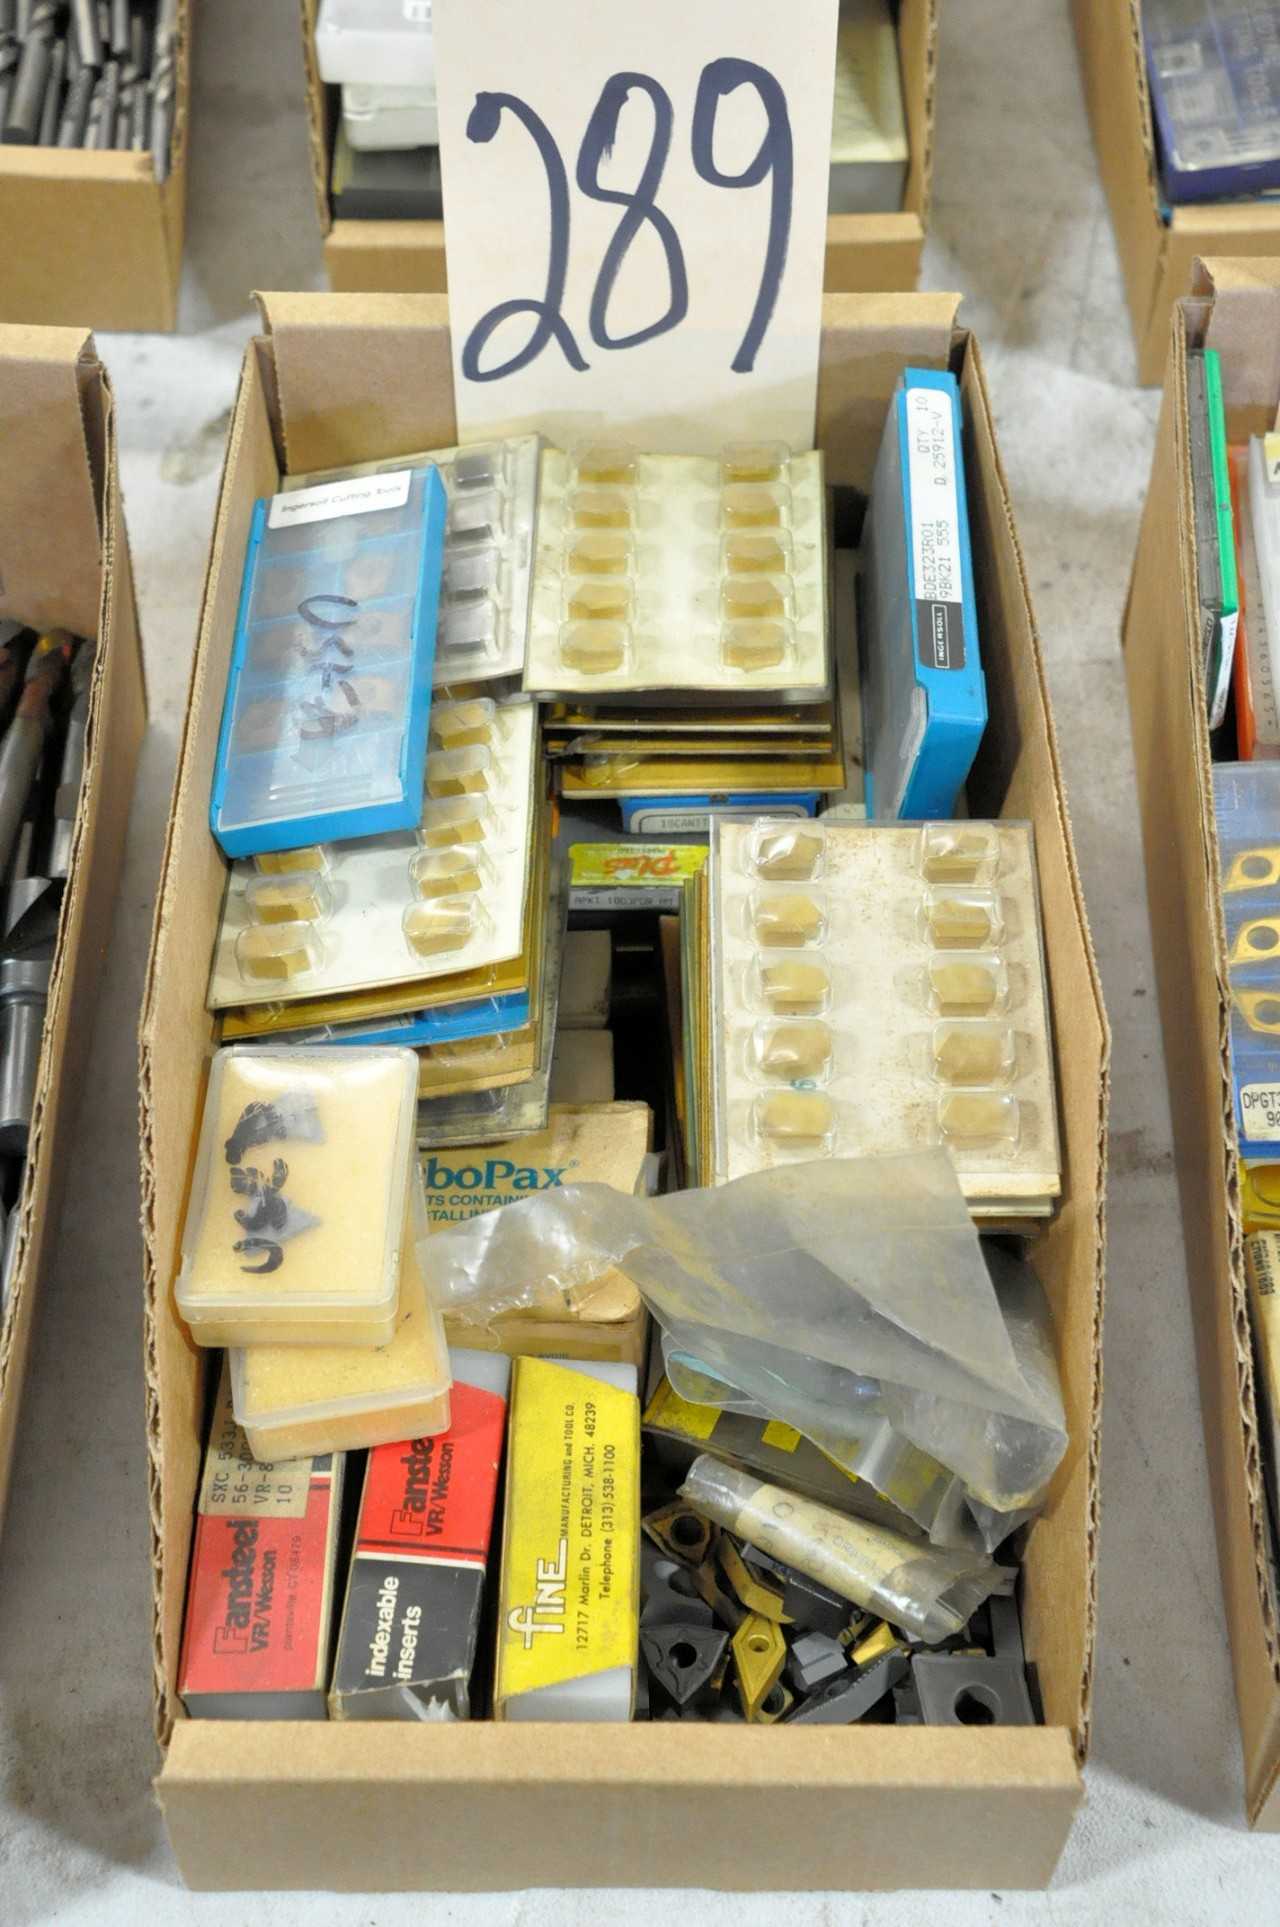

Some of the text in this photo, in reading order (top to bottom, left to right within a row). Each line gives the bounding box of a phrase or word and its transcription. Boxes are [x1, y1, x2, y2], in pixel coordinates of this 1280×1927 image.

[462, 56, 795, 383] 289
[916, 395, 931, 455] QTY 10
[933, 611, 945, 662] INGERSOLL
[424, 1156, 569, 1191] boPax
[565, 1418, 574, 1441] TOOL
[565, 1442, 573, 1458] and
[210, 1471, 230, 1504] SXC
[276, 1483, 293, 1504] 10
[390, 1437, 434, 1537] Fanste
[424, 1442, 455, 1538] VR/Wesson
[561, 1459, 572, 1537] MANUFACTURING
[576, 1401, 597, 1651] 12717 Marlin Dr. DETROIT, MICH. 48239
[599, 1443, 616, 1601] Telephone (313) 538-1100
[213, 1519, 260, 1655] Fansteel
[250, 1550, 276, 1653] VR/Wesson
[365, 1575, 400, 1678] indexable
[392, 1605, 422, 1680] inserts
